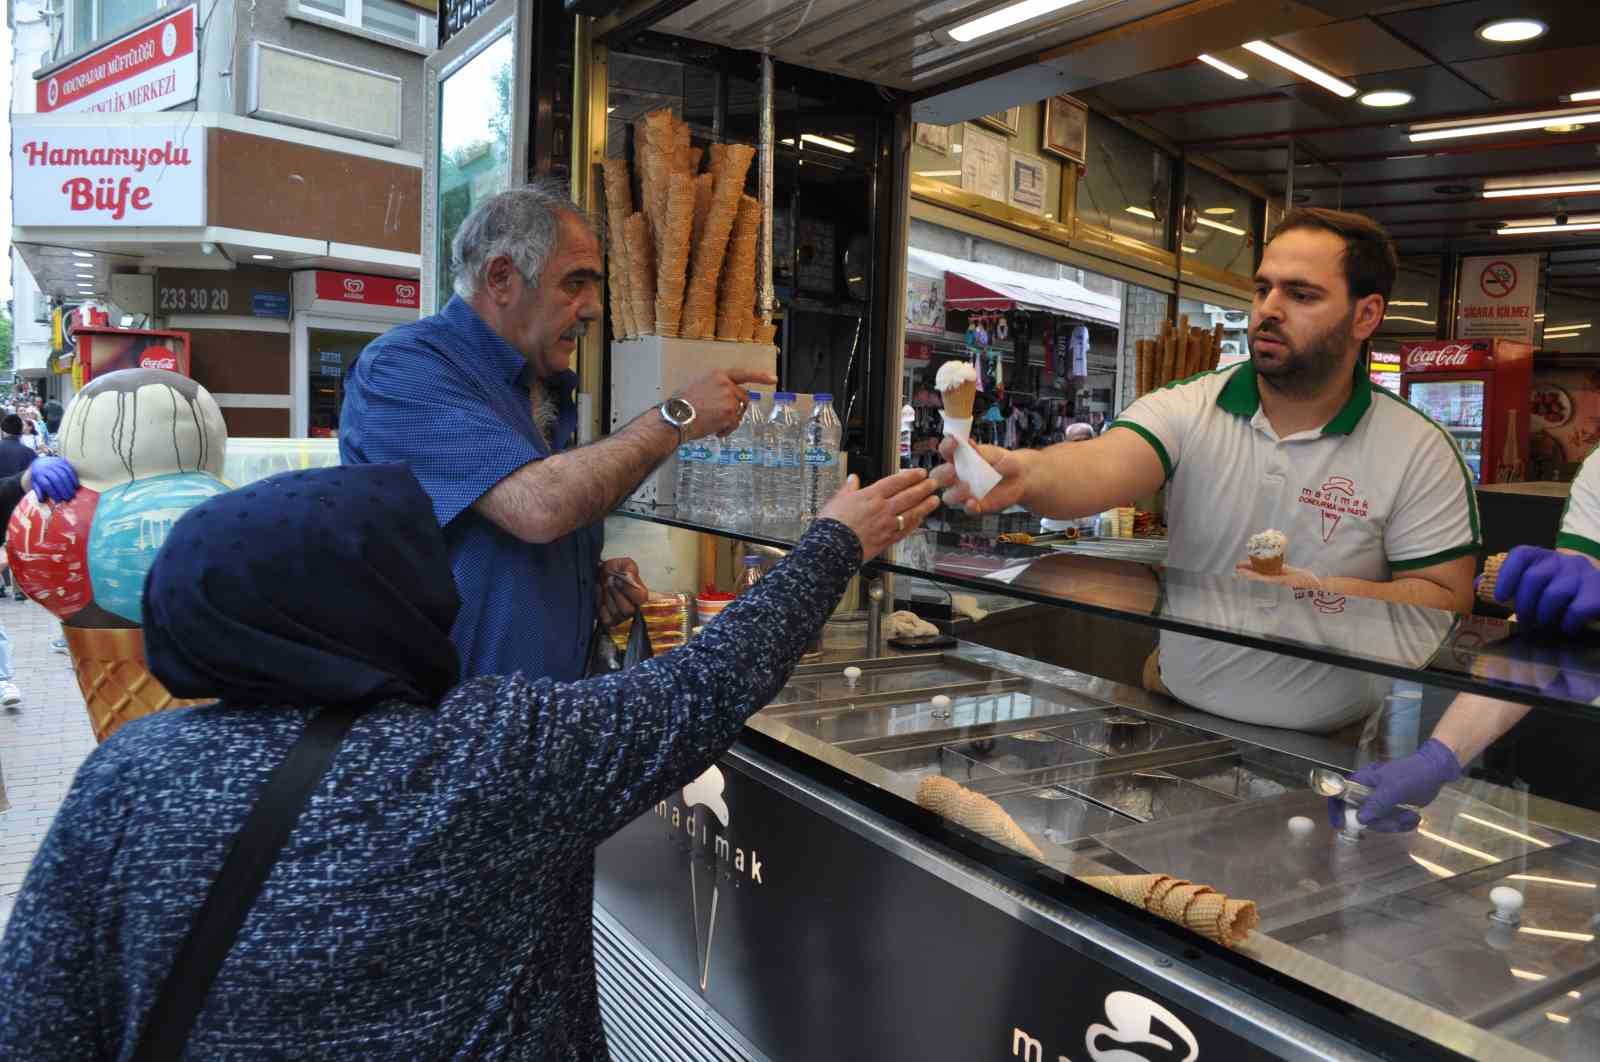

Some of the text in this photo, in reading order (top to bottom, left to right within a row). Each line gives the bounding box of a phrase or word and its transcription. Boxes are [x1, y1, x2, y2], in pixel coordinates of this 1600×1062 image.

[128, 69, 176, 107] MERKEZİ
[22, 140, 192, 172] Hamamyolu
[61, 176, 153, 220] Büfe
[160, 288, 186, 309] 233
[191, 288, 207, 310] 30
[211, 288, 229, 311] 20
